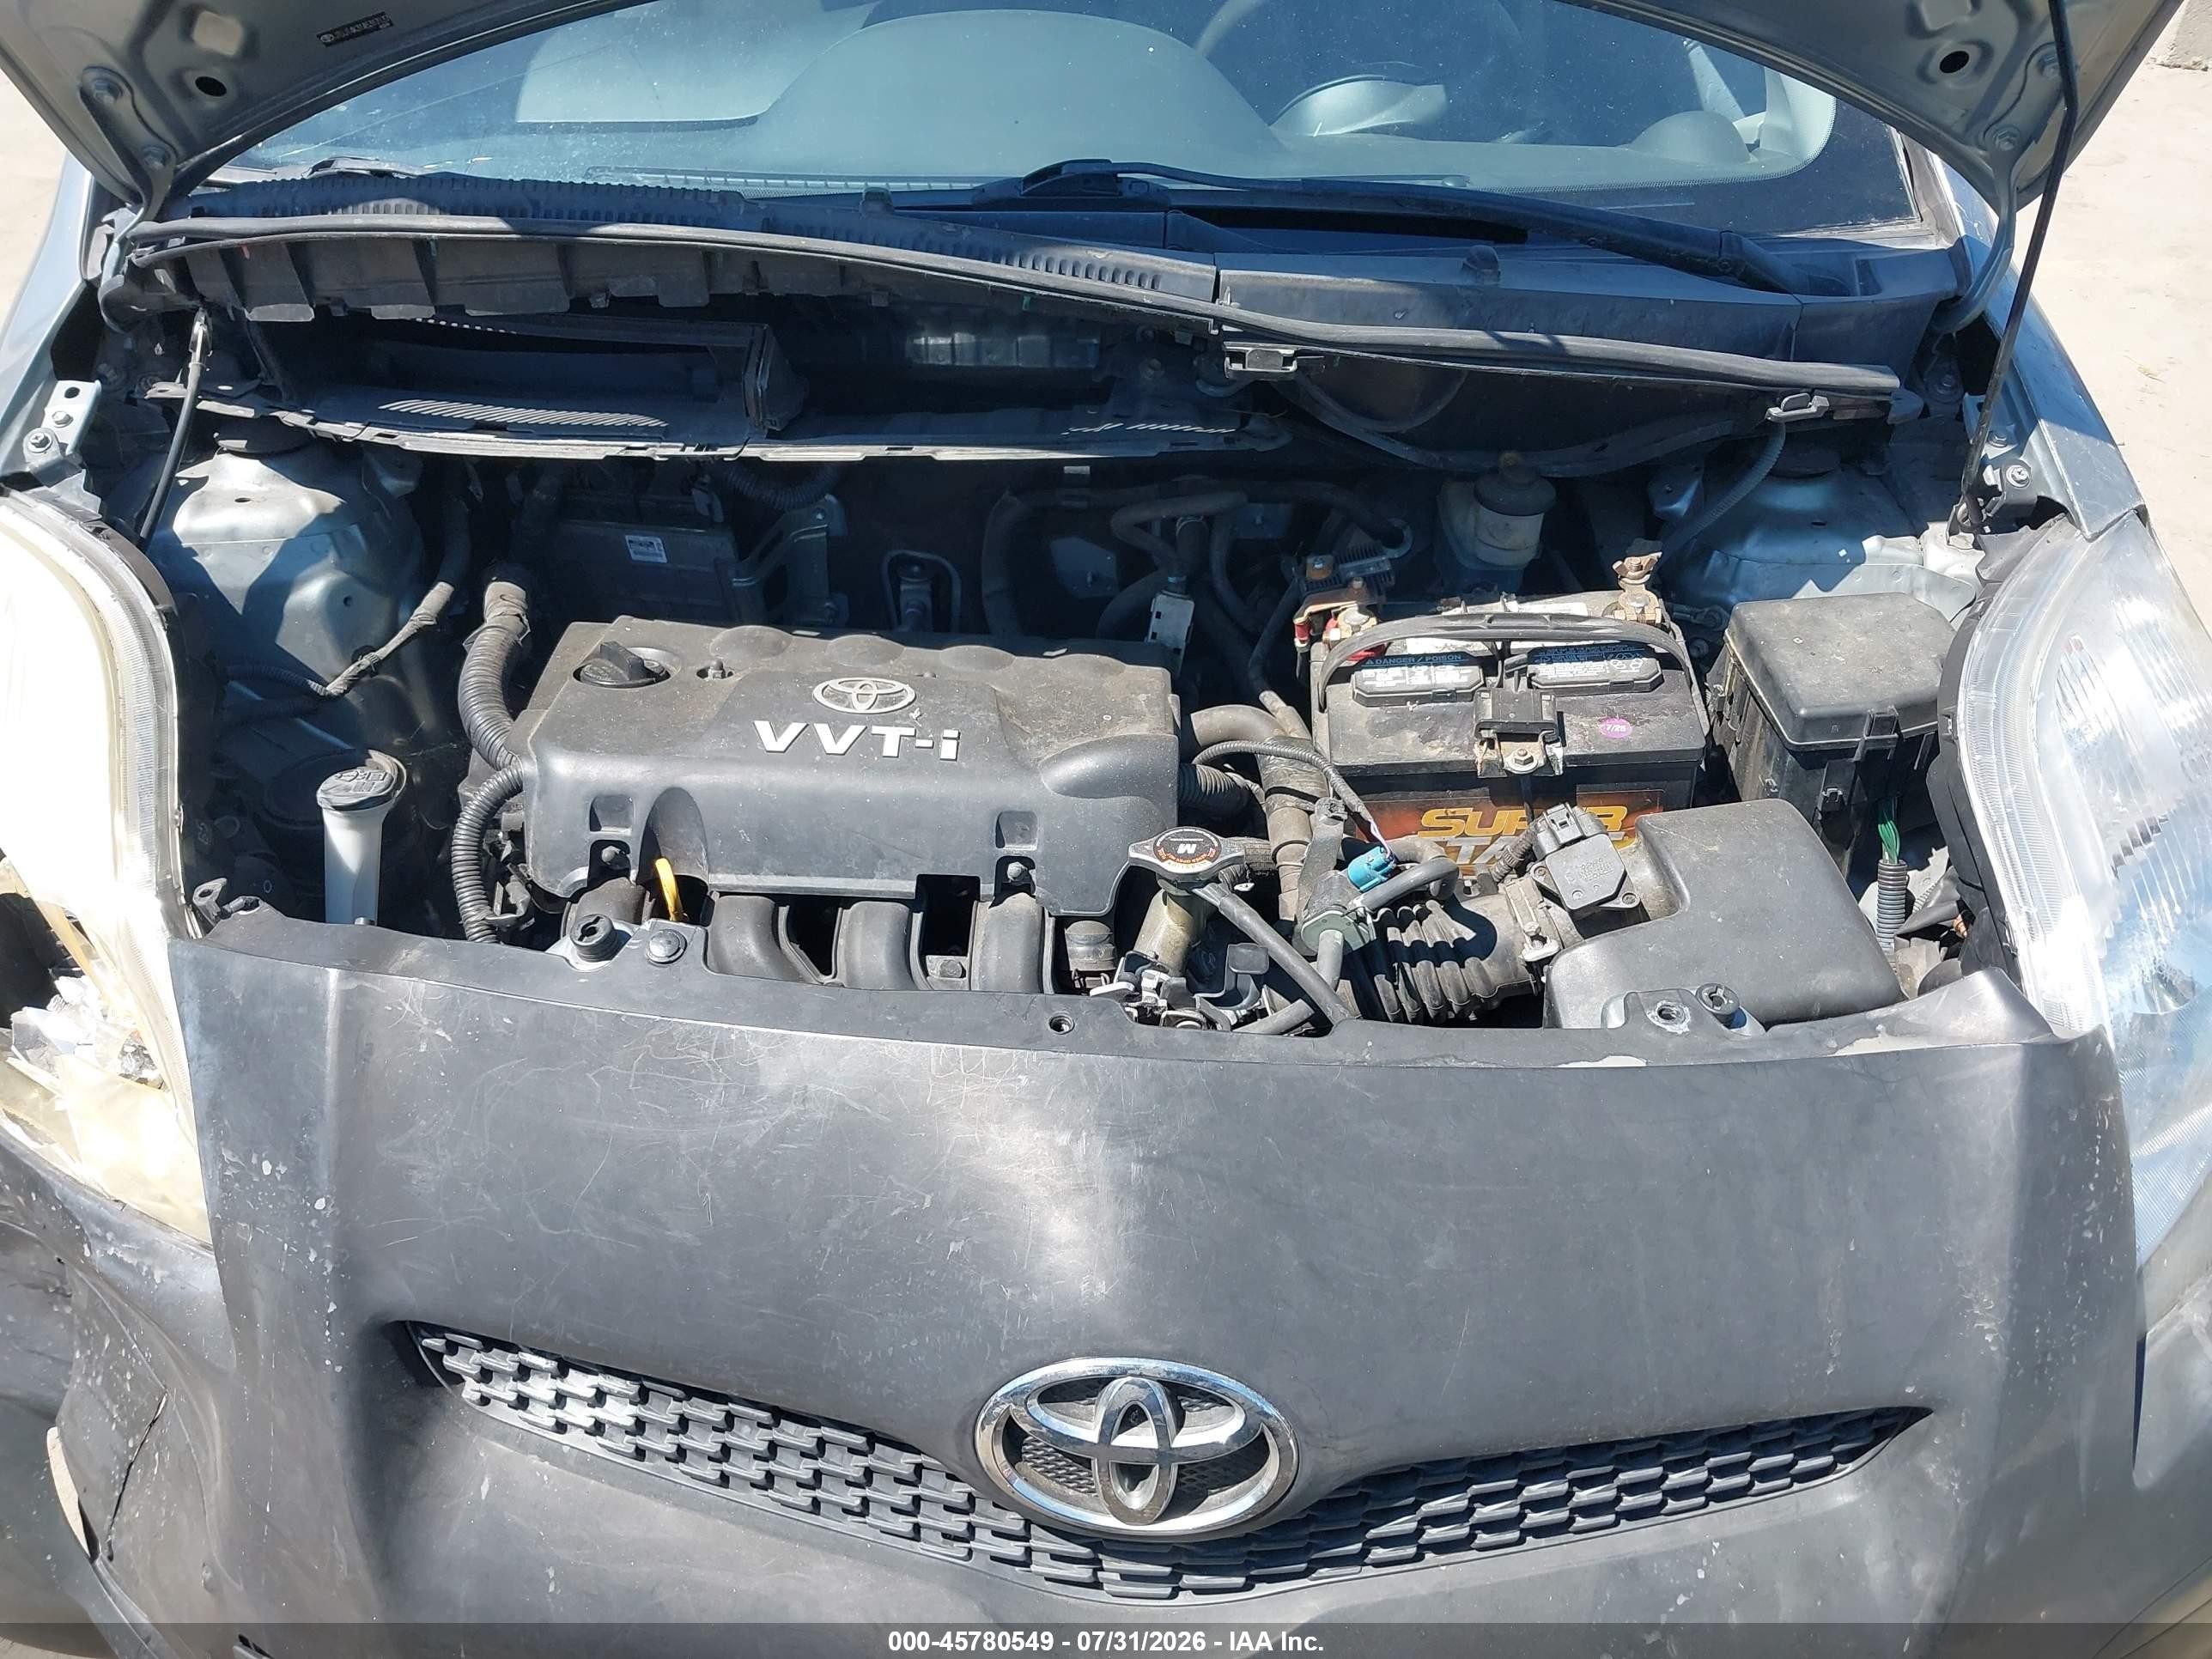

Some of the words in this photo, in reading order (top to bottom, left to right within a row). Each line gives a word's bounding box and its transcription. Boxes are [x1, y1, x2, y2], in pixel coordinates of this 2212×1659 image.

[1375, 656, 1415, 665] DANGER
[1425, 653, 1462, 662] POISON
[753, 720, 960, 761] VVT-i
[1418, 805, 1628, 839] SUPR
